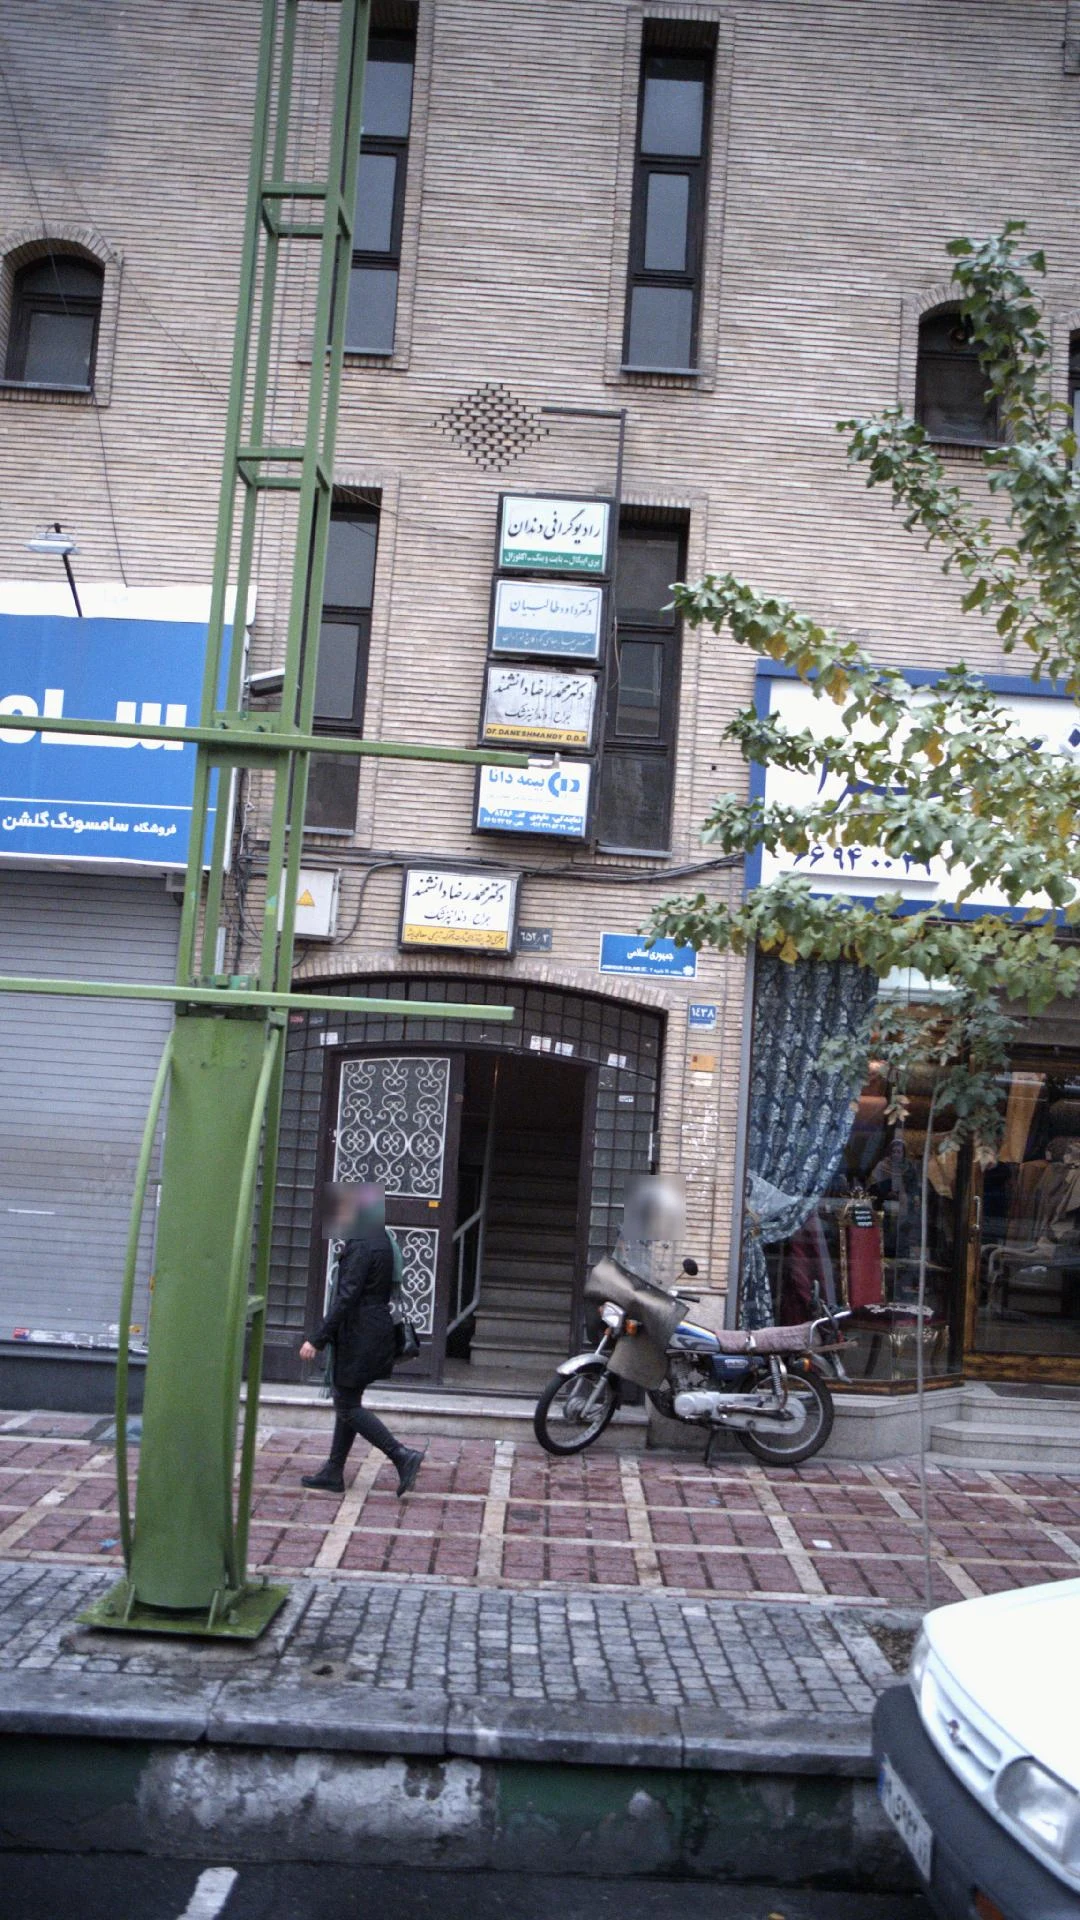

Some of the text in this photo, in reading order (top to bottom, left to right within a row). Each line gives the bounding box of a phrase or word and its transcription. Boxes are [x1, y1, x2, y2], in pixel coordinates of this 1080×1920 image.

[507, 508, 601, 544] رادیوگرافی دندان
[576, 596, 599, 617] دکتر
[494, 673, 527, 695] دانشمند
[561, 680, 587, 703] دکتر
[489, 768, 545, 791] بیمه دانا
[2, 811, 177, 836] فروشگاه سامسونگ گلشن
[412, 876, 447, 897] دانشمند
[481, 882, 507, 906] دکتر
[627, 947, 674, 961] جمهوری اسلامی
